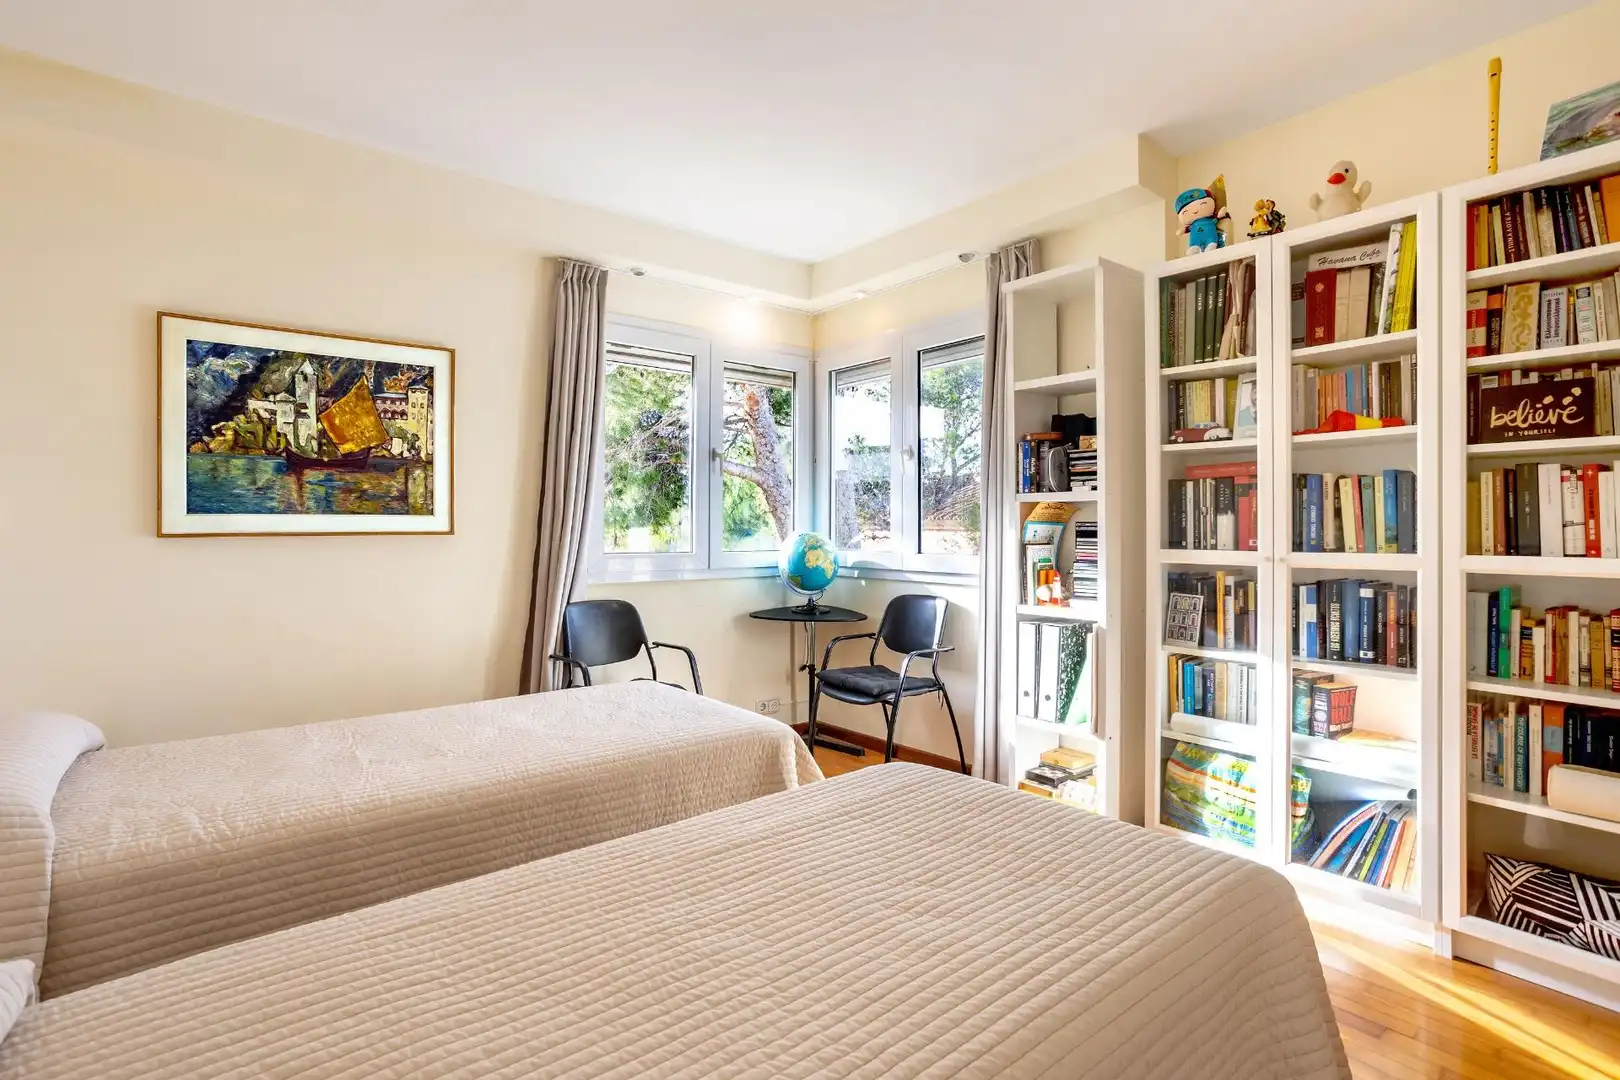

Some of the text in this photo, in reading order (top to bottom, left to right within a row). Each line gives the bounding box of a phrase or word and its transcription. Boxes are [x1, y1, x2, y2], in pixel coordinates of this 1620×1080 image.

[1317, 248, 1383, 267] Havana Cuba
[1490, 397, 1585, 428] believe
[1518, 428, 1556, 437] YOURSELF
[1331, 690, 1356, 707] WOLF
[1332, 706, 1353, 724] HALL
[1517, 727, 1525, 746] COURSE
